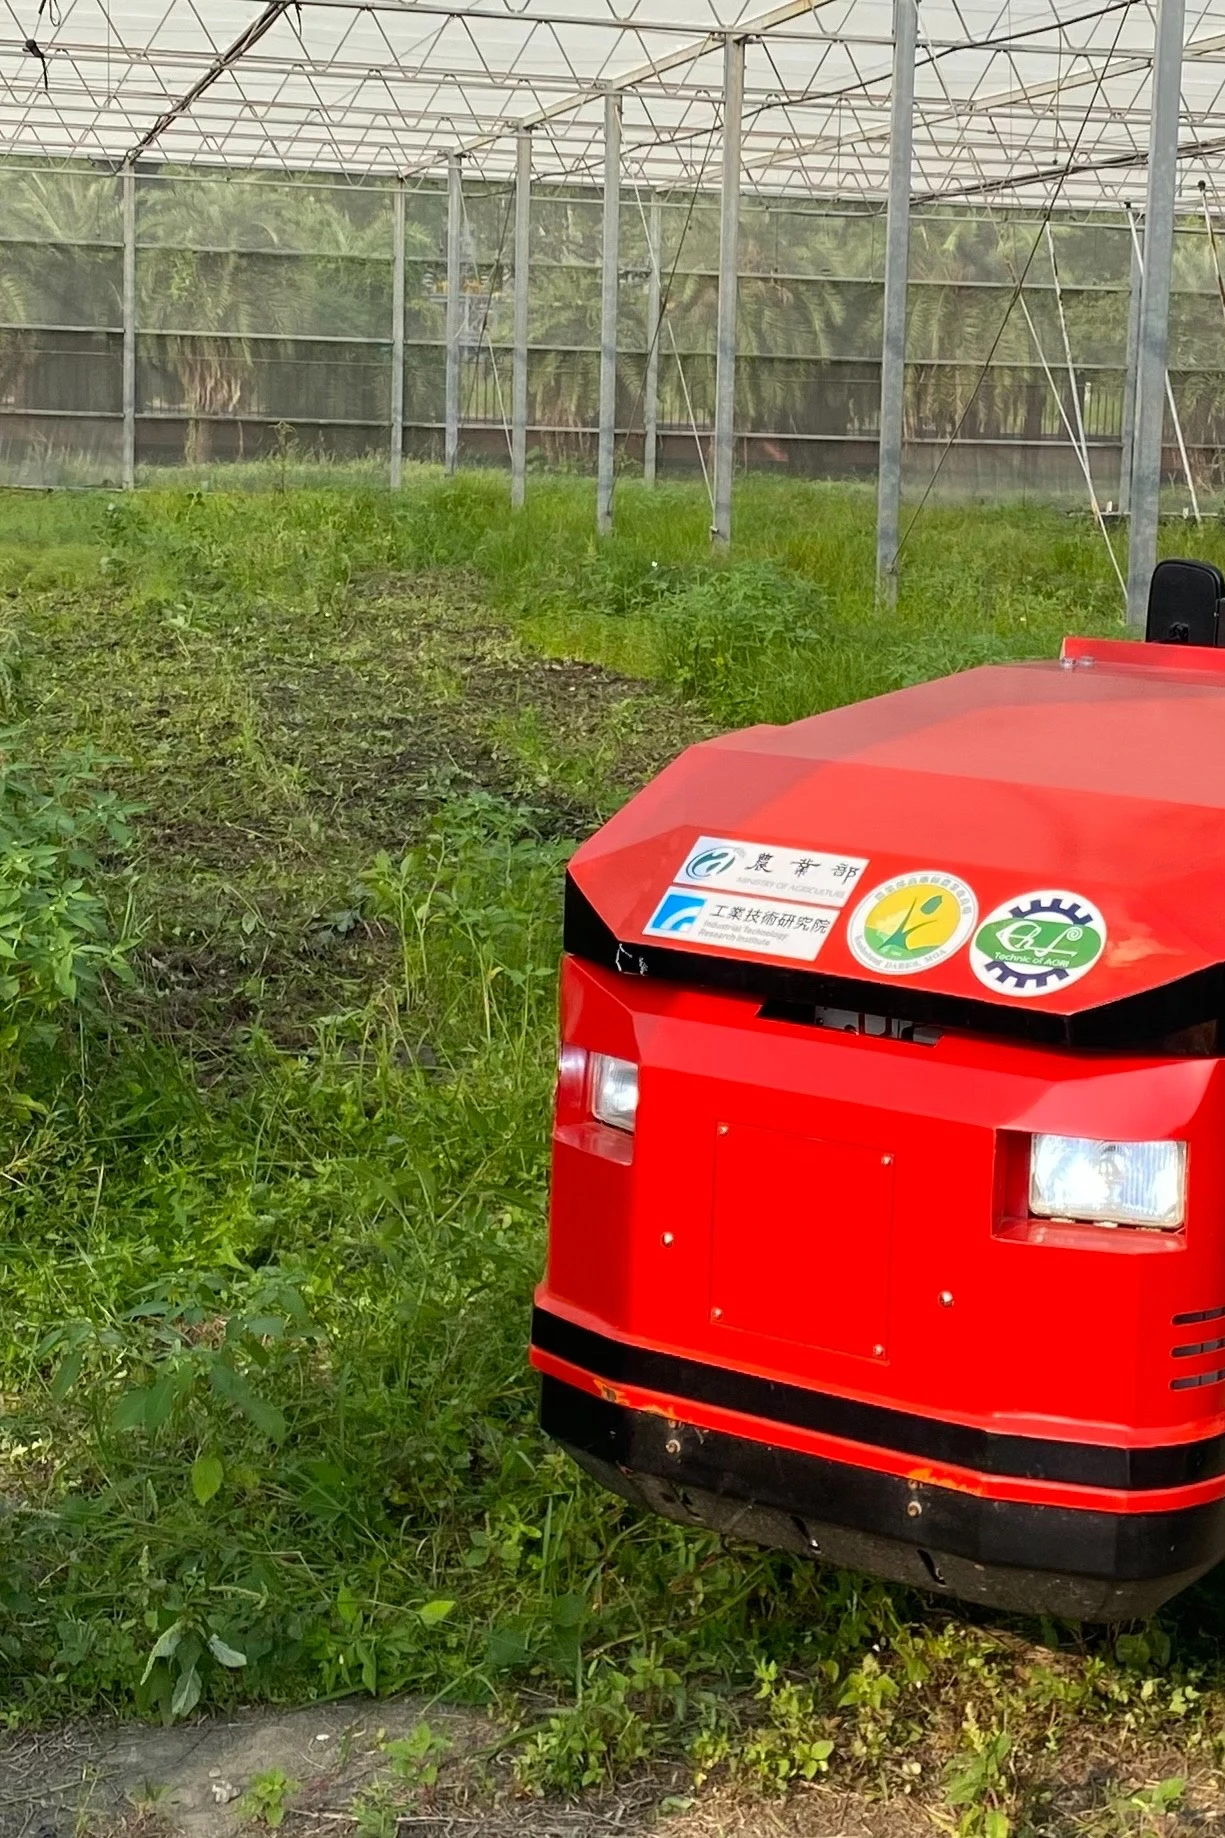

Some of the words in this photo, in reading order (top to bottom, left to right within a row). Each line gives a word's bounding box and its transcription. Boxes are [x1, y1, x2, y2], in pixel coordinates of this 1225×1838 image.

[775, 881, 788, 890] OF
[709, 904, 831, 934] 工業技術研究院
[698, 928, 737, 941] Research
[736, 934, 771, 946] Institute
[704, 920, 742, 933] Industrial
[743, 926, 789, 941] Technology
[994, 952, 1031, 964] Technic
[1032, 956, 1044, 965] of
